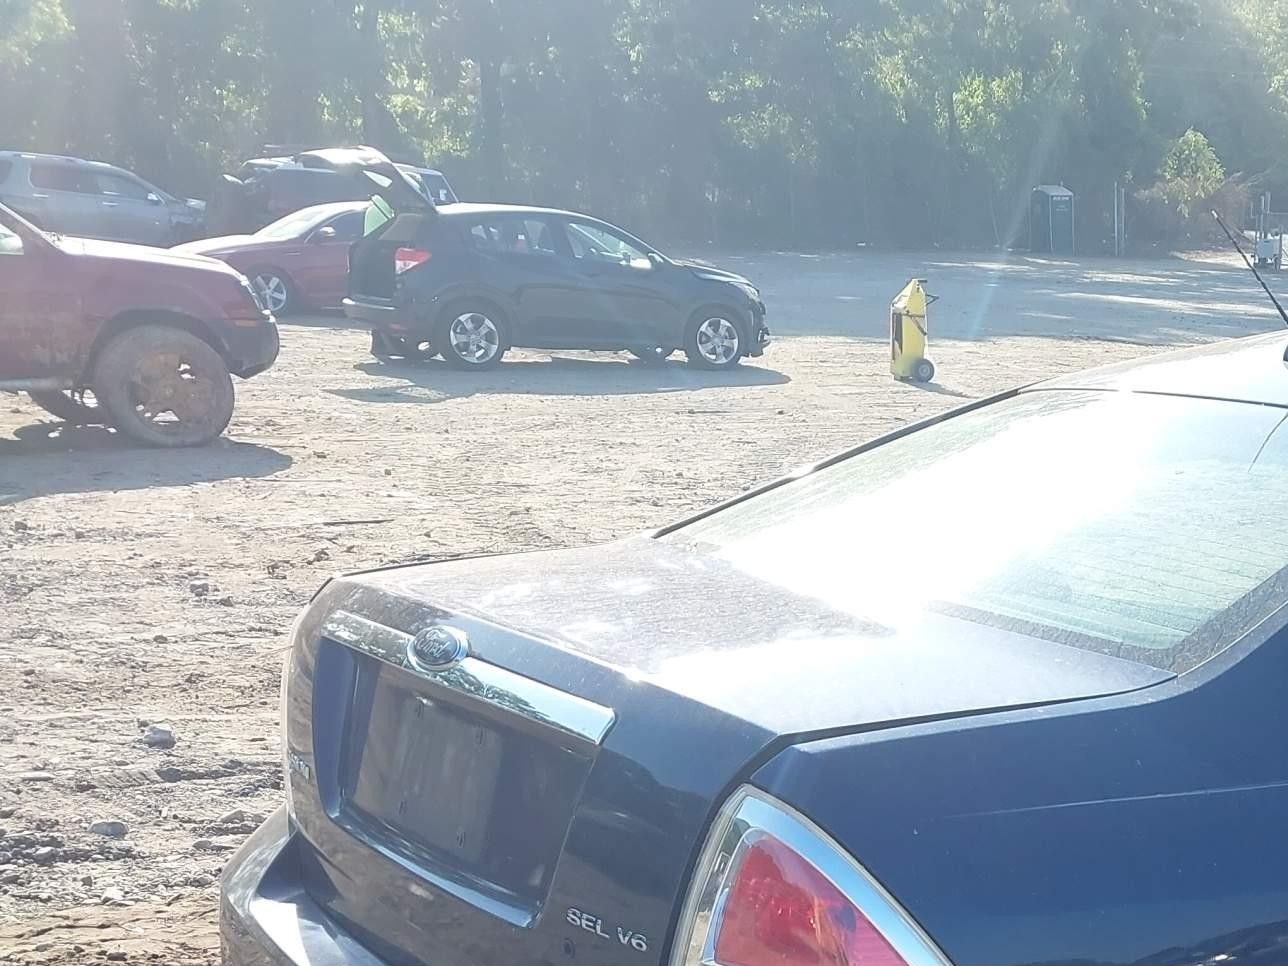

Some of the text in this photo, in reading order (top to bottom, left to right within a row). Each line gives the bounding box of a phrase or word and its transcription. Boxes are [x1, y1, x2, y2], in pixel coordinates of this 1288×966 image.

[416, 629, 451, 658] Ford
[566, 907, 649, 952] SEL V6
